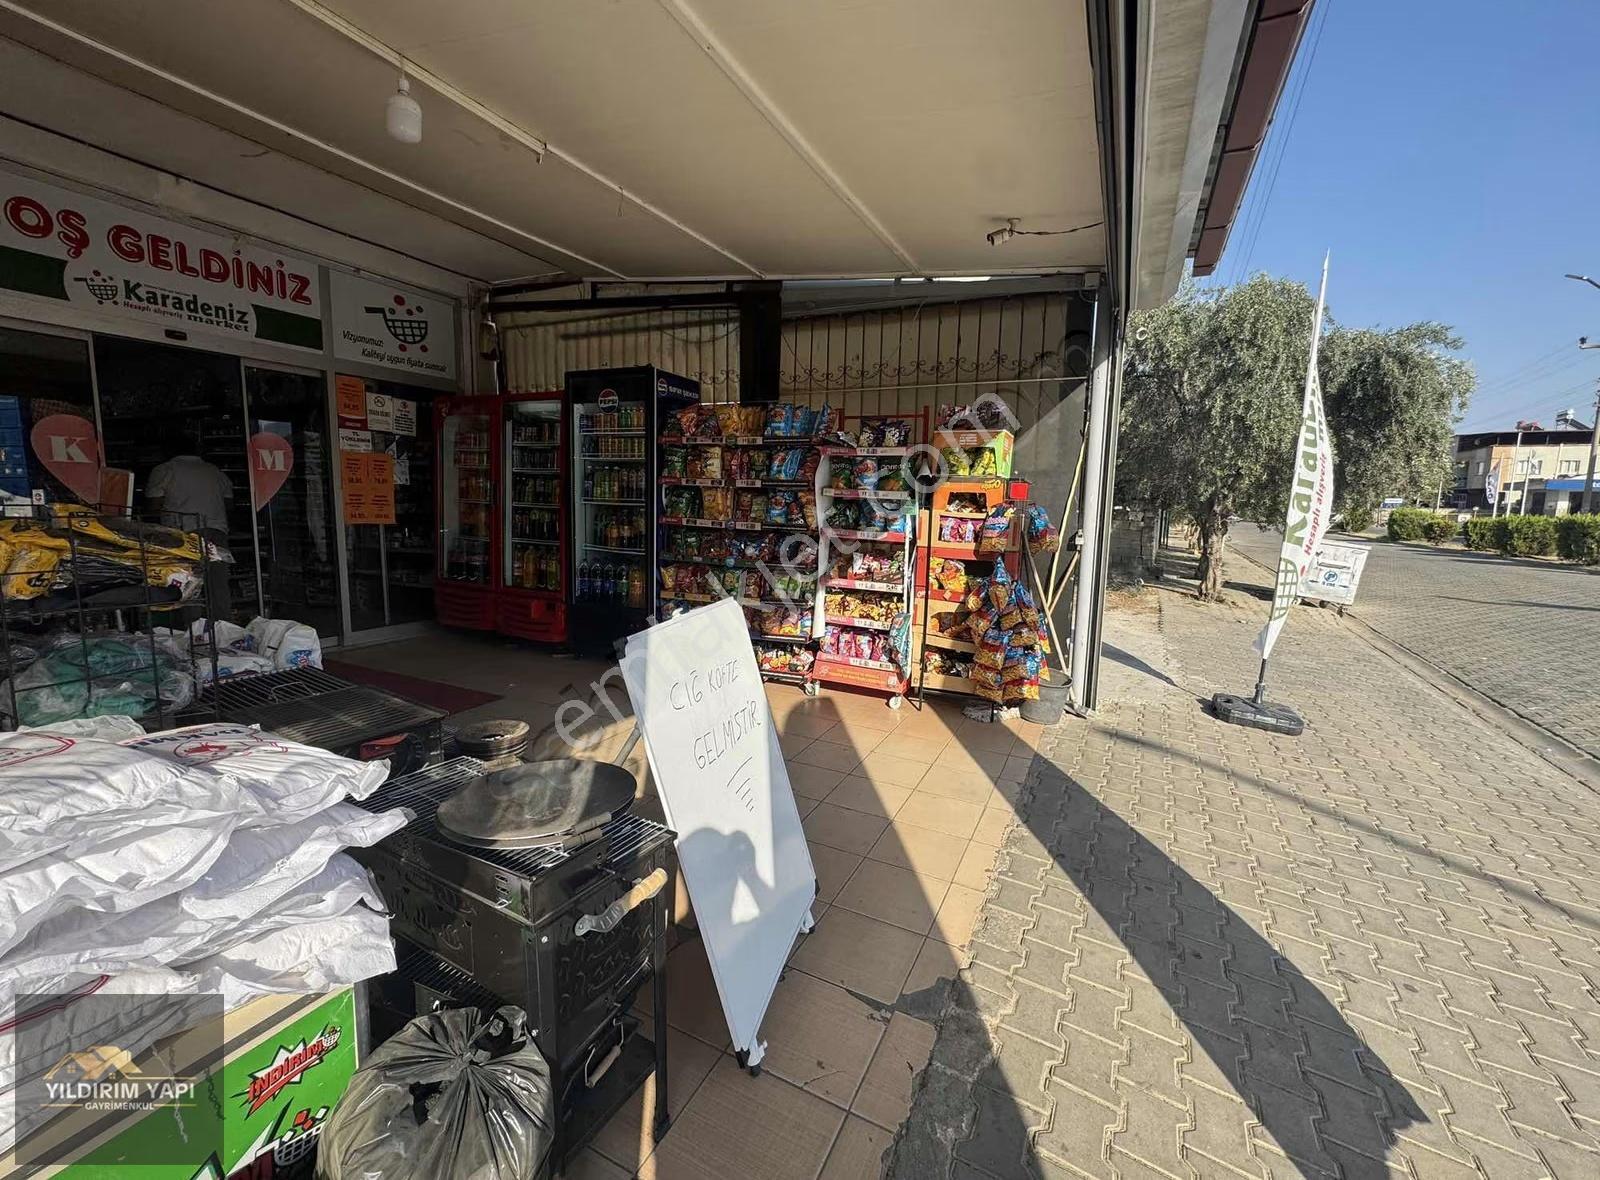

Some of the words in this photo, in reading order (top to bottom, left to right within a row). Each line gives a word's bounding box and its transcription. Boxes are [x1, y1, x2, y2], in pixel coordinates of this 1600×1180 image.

[107, 224, 313, 306] GELDİNİZ
[123, 279, 249, 325] Karadeniz
[186, 313, 249, 333] market
[599, 398, 618, 406] PEPSI
[48, 436, 95, 464] K
[256, 449, 288, 472] M
